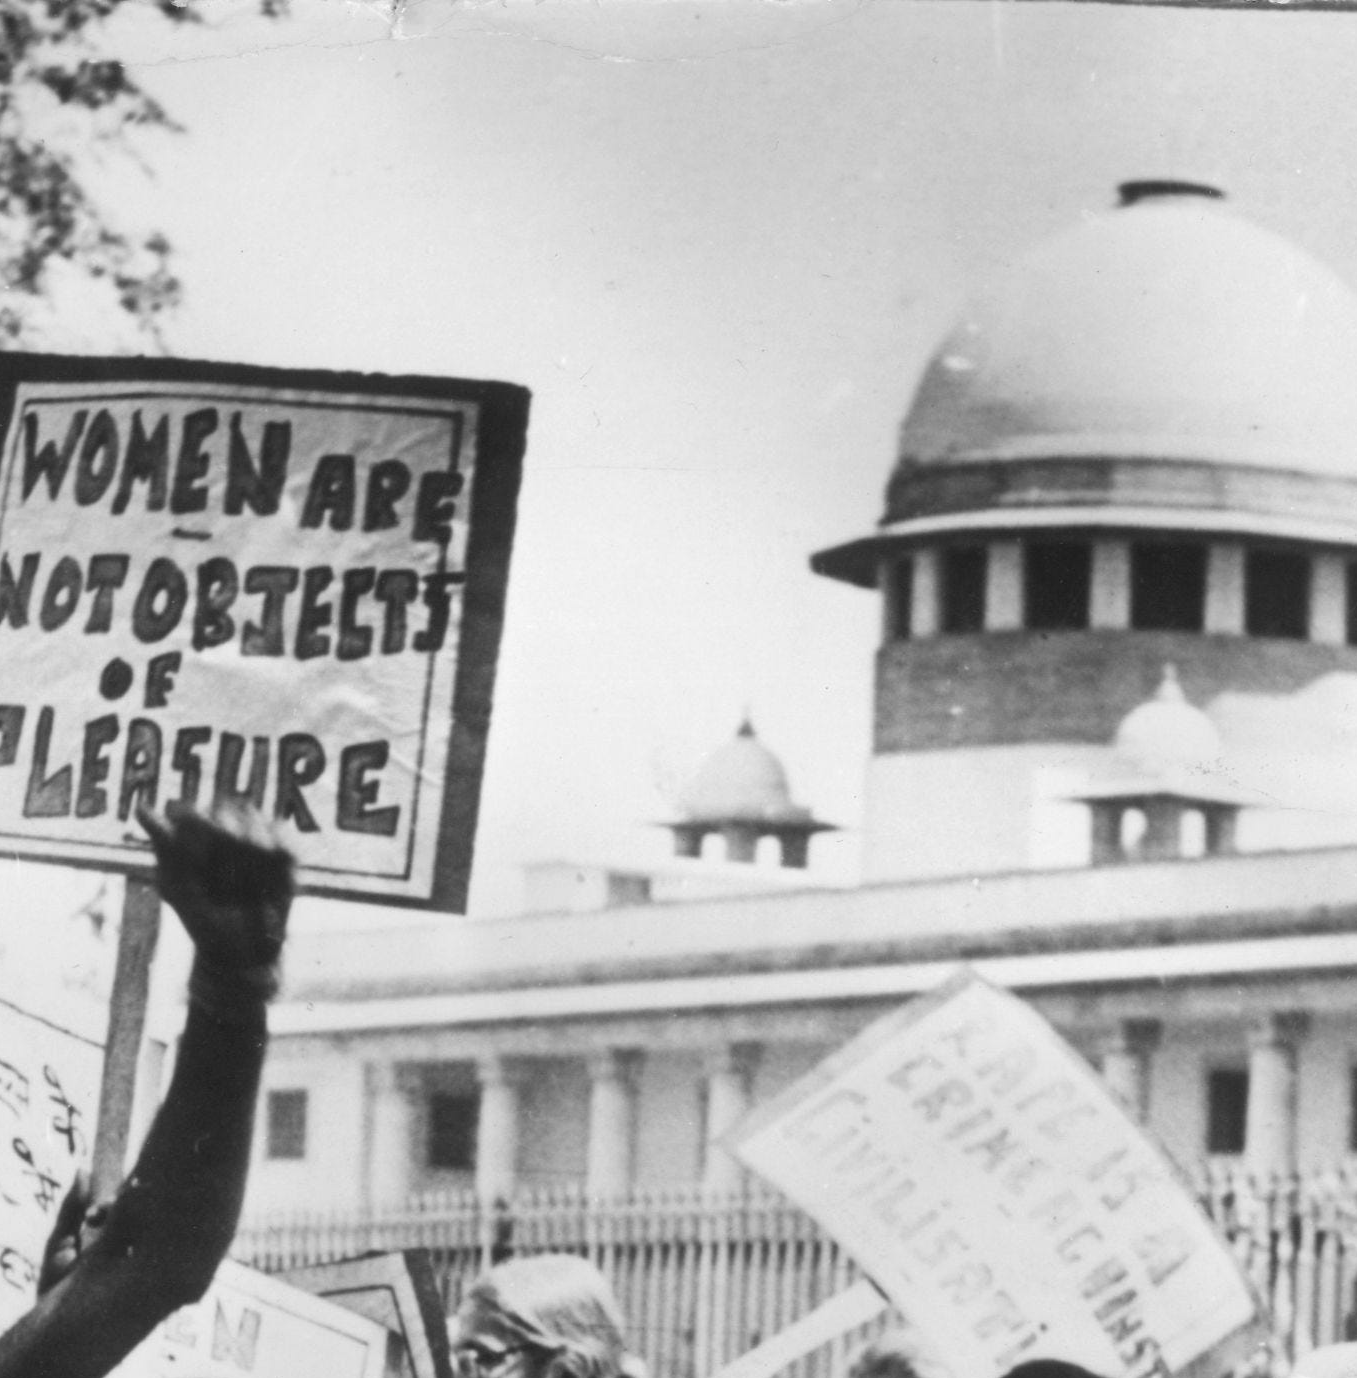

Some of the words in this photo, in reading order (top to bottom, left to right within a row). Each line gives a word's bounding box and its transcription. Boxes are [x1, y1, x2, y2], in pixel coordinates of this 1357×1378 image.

[22, 407, 293, 517] WOMEN
[298, 454, 464, 543] ARE
[98, 651, 182, 708] OF
